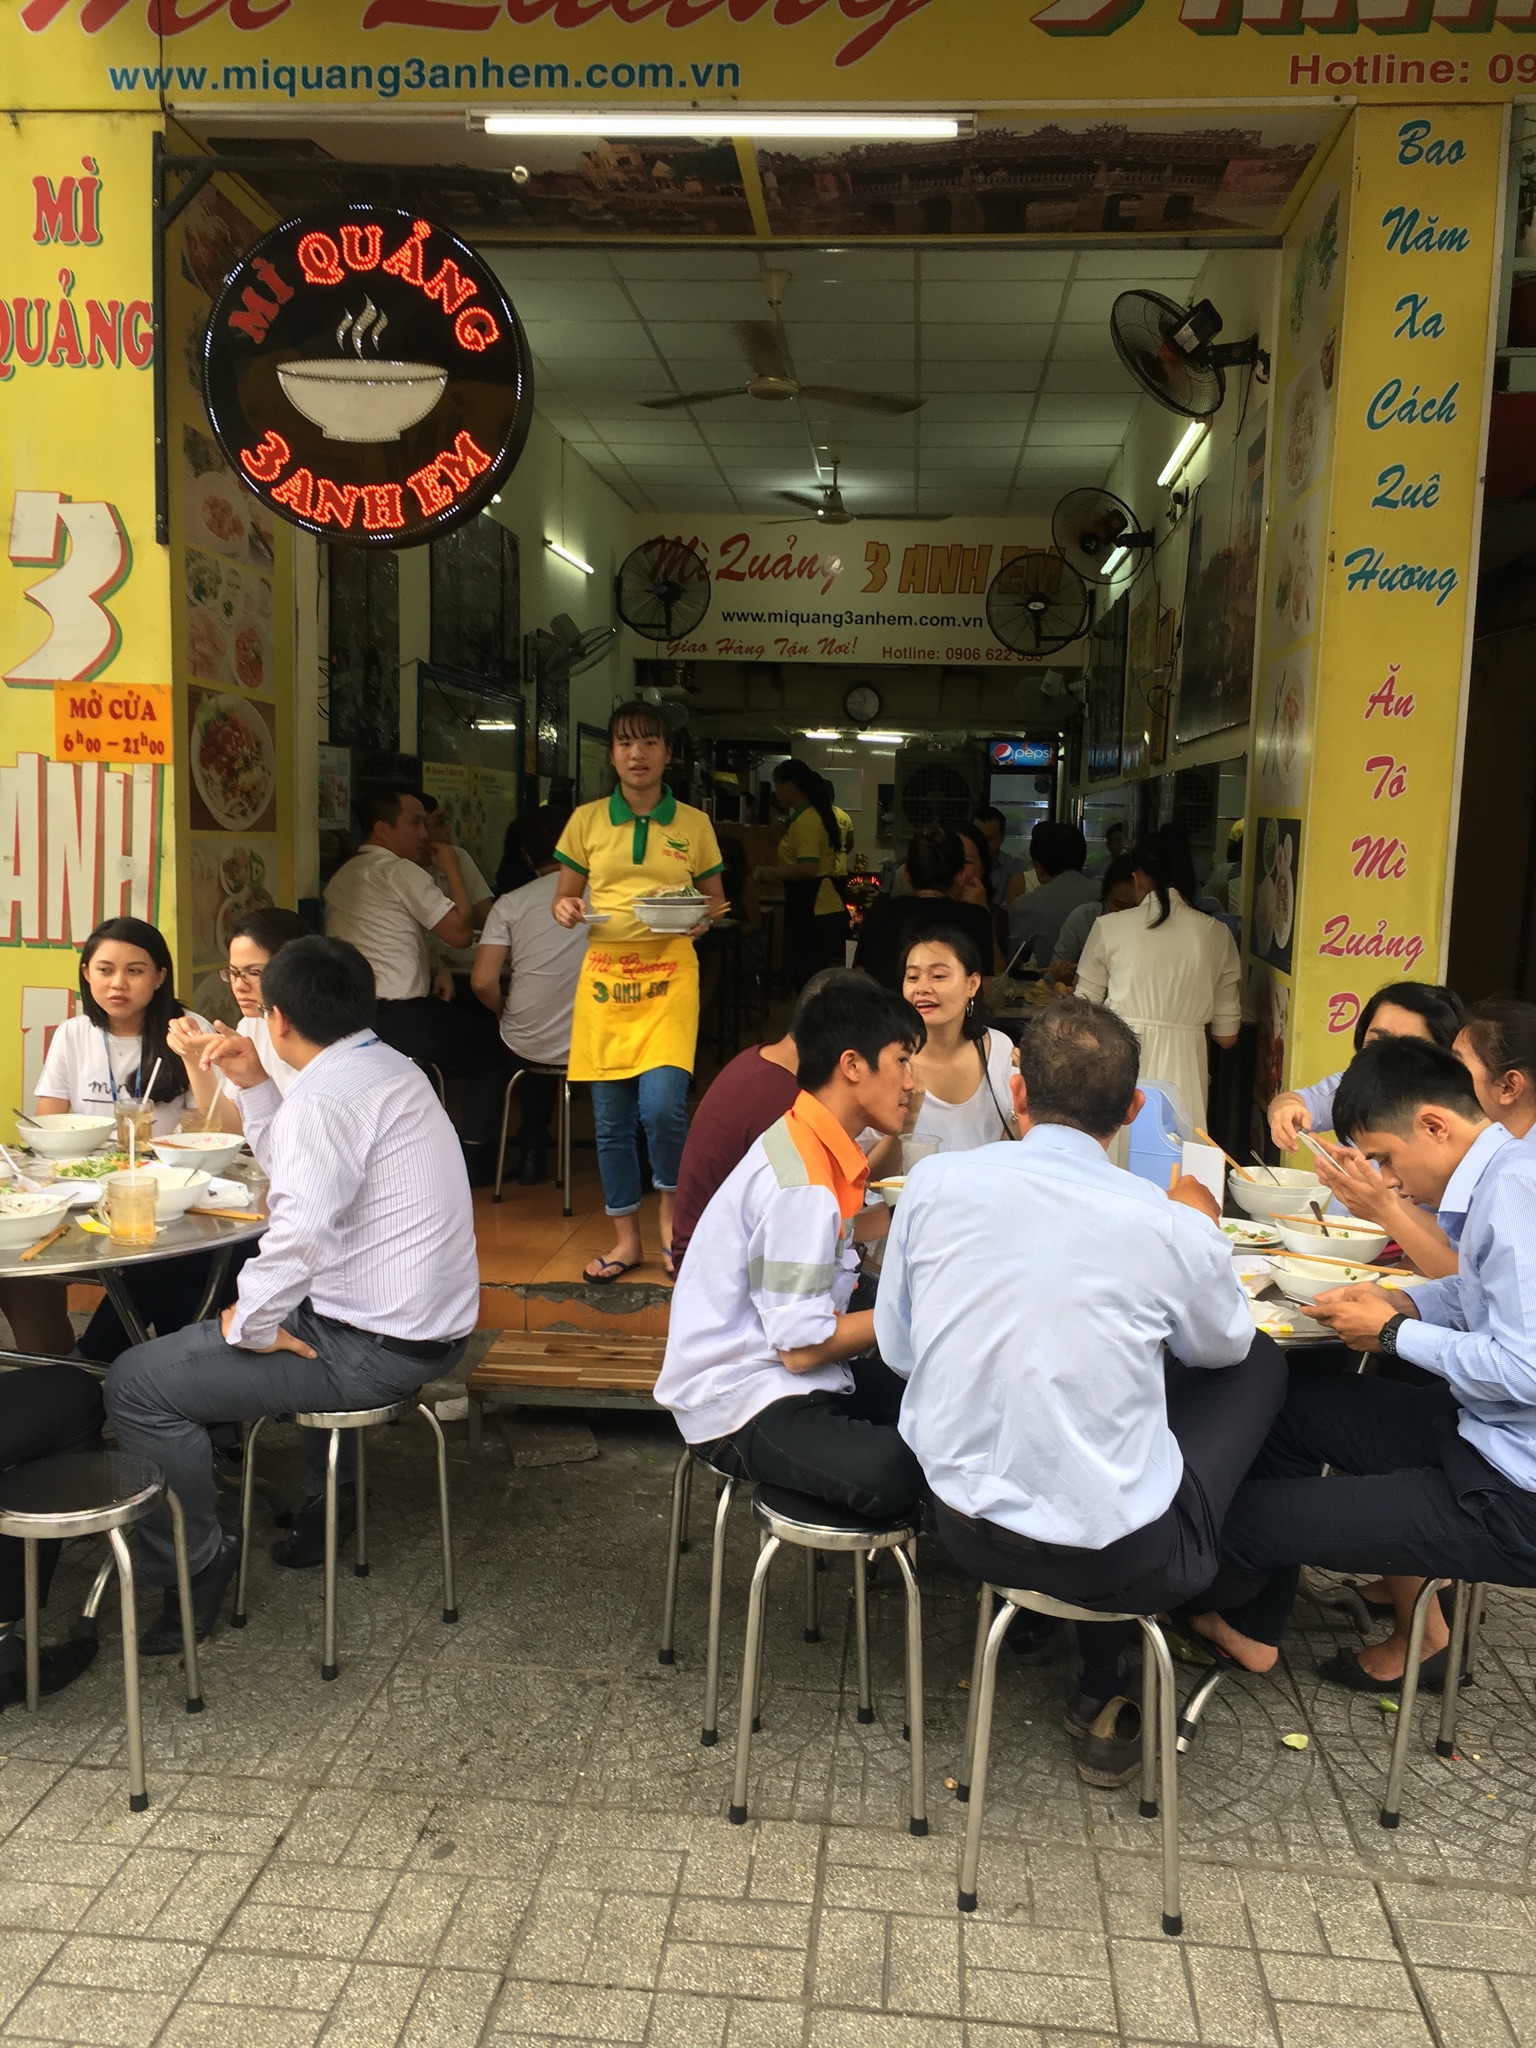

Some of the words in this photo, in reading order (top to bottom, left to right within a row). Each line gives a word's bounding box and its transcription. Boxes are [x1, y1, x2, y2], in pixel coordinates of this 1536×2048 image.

[109, 57, 740, 98] www.miquang3anhem.com.vn
[1289, 53, 1468, 86] Hotline:
[1398, 119, 1467, 166] Bao
[32, 155, 103, 246] MÌ
[1381, 206, 1471, 256] Năm
[228, 257, 295, 345] MÌ
[297, 219, 500, 352] QUẢNG
[1393, 293, 1446, 340] Xa
[1366, 378, 1461, 431] Cách
[240, 430, 291, 482] 3
[271, 467, 406, 529] ANH
[406, 430, 492, 516] EM
[1371, 463, 1442, 510] Quê
[715, 532, 843, 596] Quảng
[860, 541, 891, 594] 3
[897, 543, 994, 595] ANH
[1343, 547, 1459, 607] Hương
[2, 490, 133, 690] 3
[721, 609, 984, 628] www.miquang3anhem.com.vn
[715, 636, 765, 661] Hàng
[882, 646, 940, 660] Hotline:
[945, 646, 980, 661] 0906
[1364, 663, 1415, 720] Ăn
[1014, 747, 1053, 760] pepsi
[1365, 755, 1407, 800] Tô
[1351, 834, 1408, 880] Mì
[1318, 914, 1425, 972] Quảng
[592, 981, 610, 1004] 3
